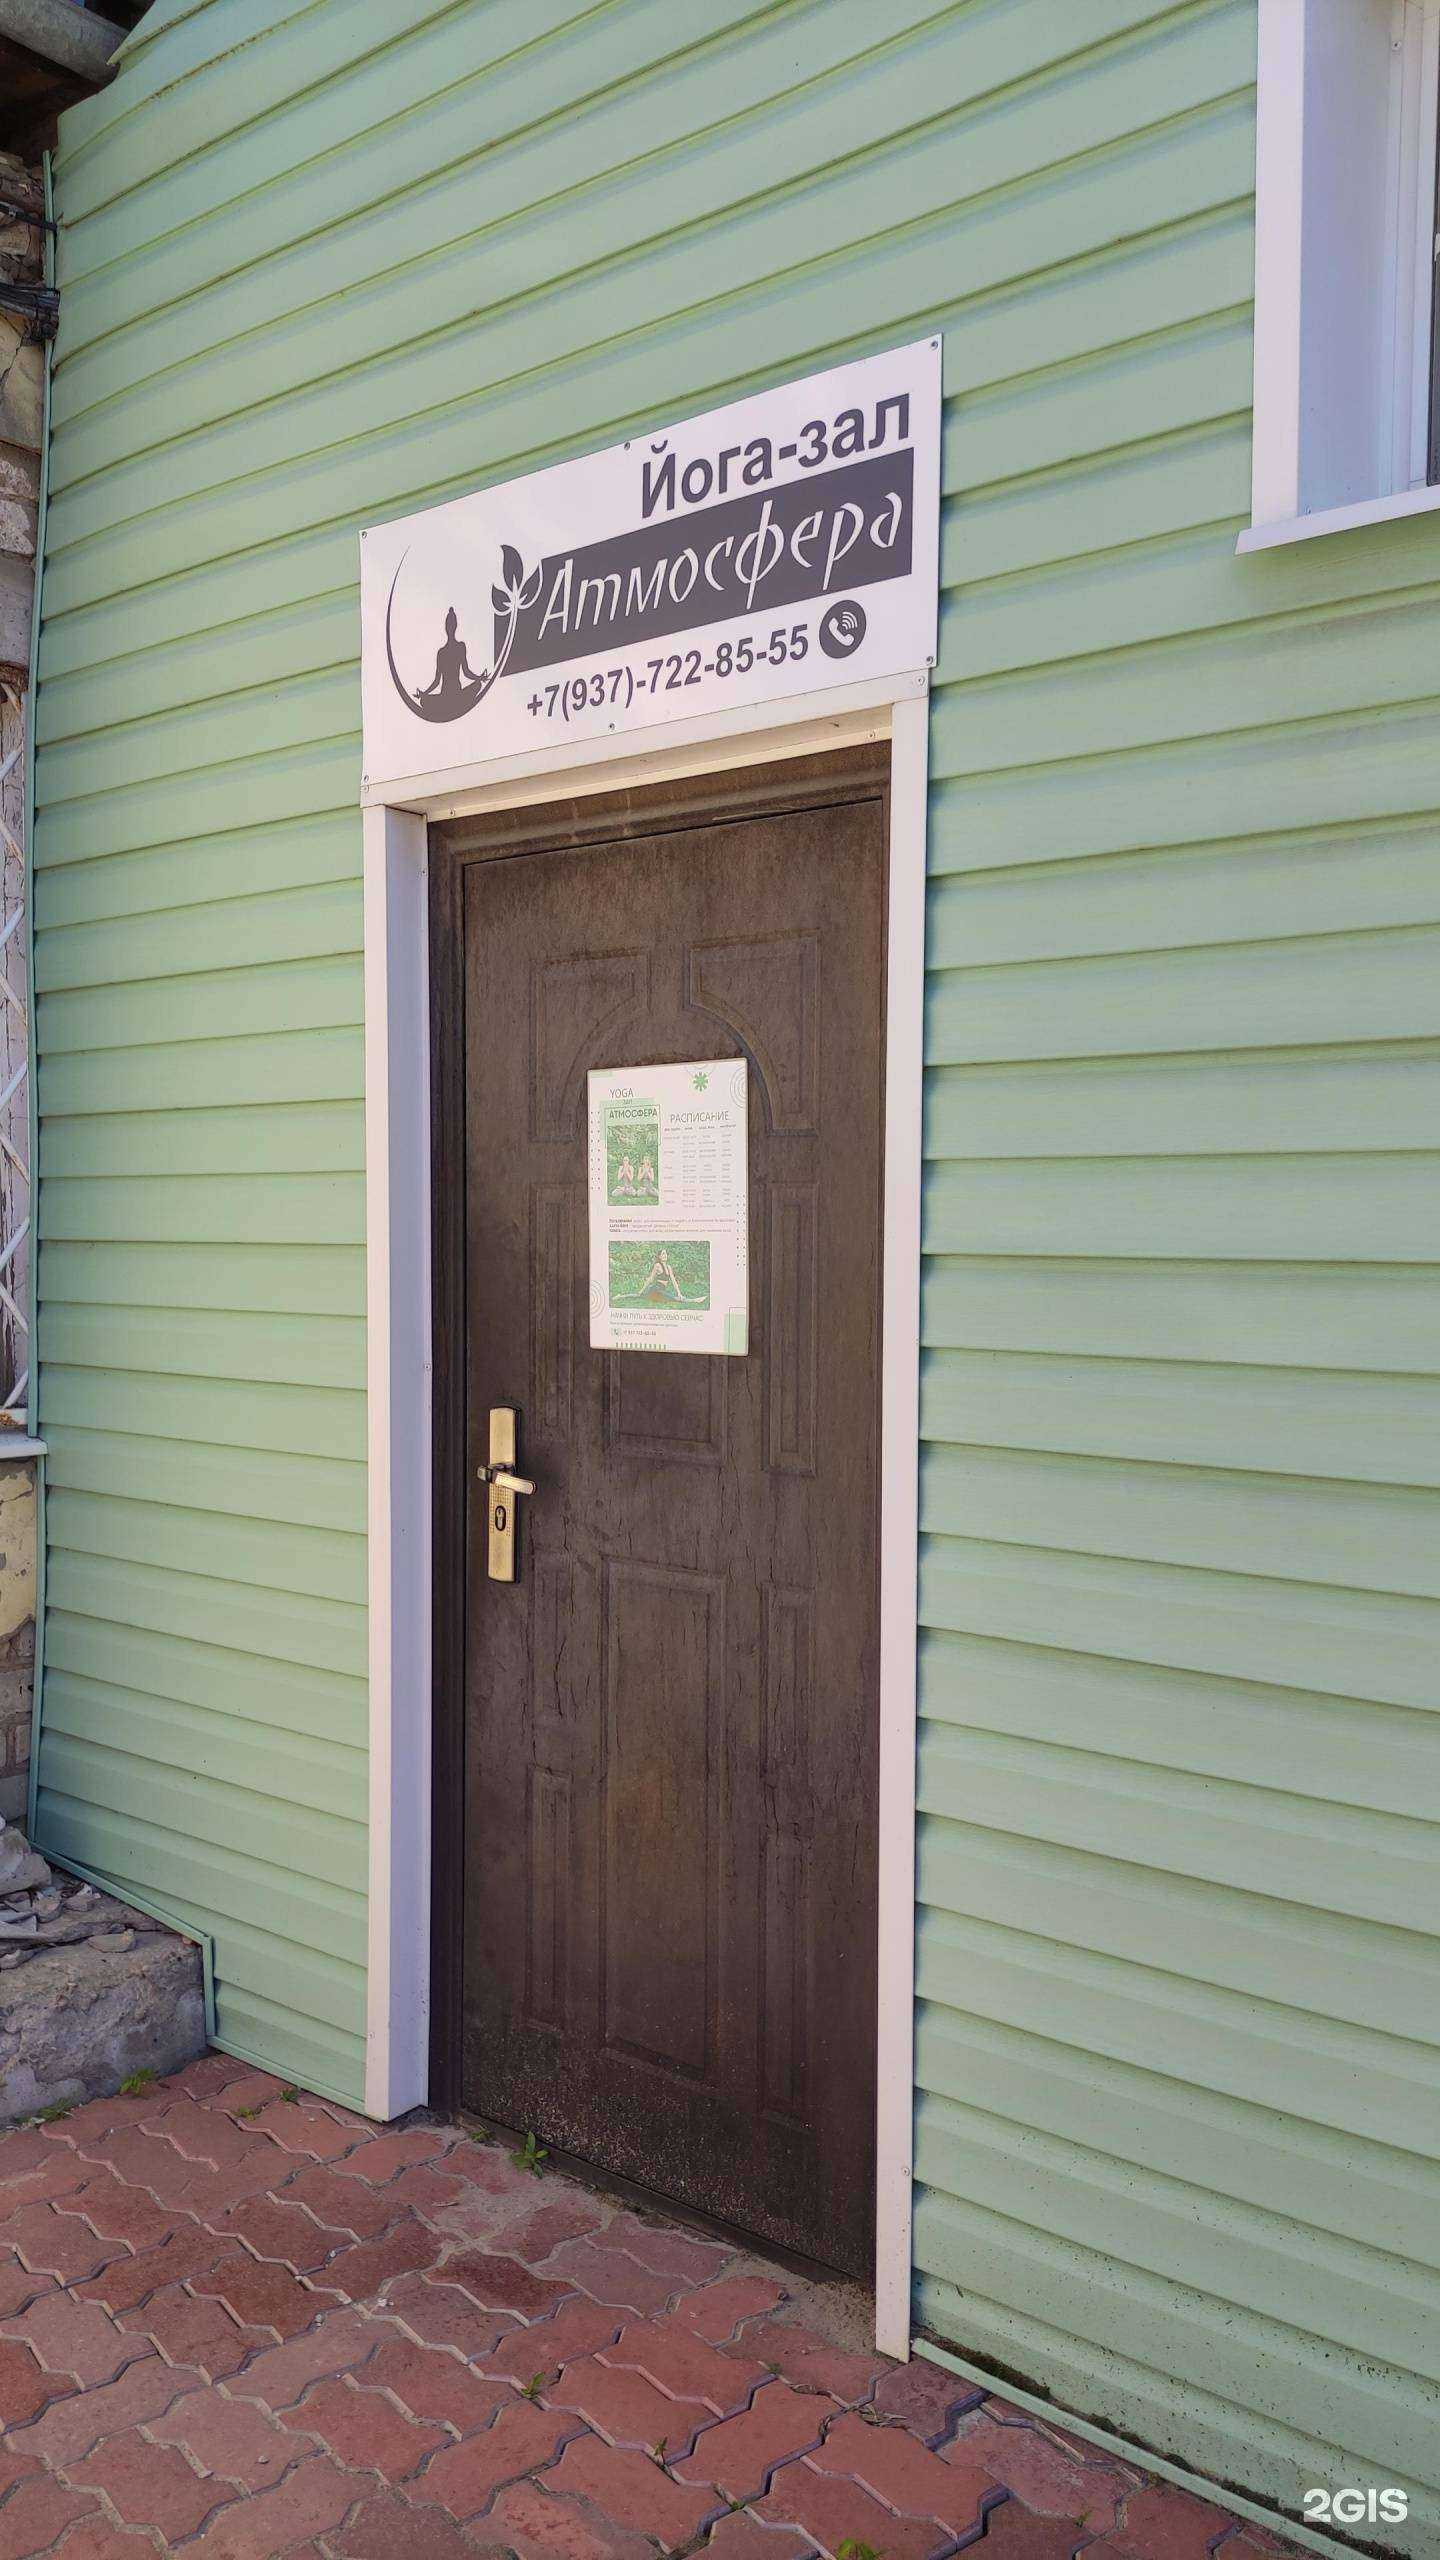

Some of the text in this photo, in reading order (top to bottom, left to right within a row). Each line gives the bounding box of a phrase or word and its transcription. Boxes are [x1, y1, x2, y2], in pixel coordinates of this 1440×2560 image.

[642, 392, 910, 519] Йога-зал
[538, 492, 903, 640] Атмосфера
[526, 623, 809, 722] +7(937)-722-85-55
[609, 1108, 658, 1119] АТМОСФЕРА
[610, 1088, 634, 1098] YOGA
[670, 1111, 729, 1123] РАСПИСАНИЕ
